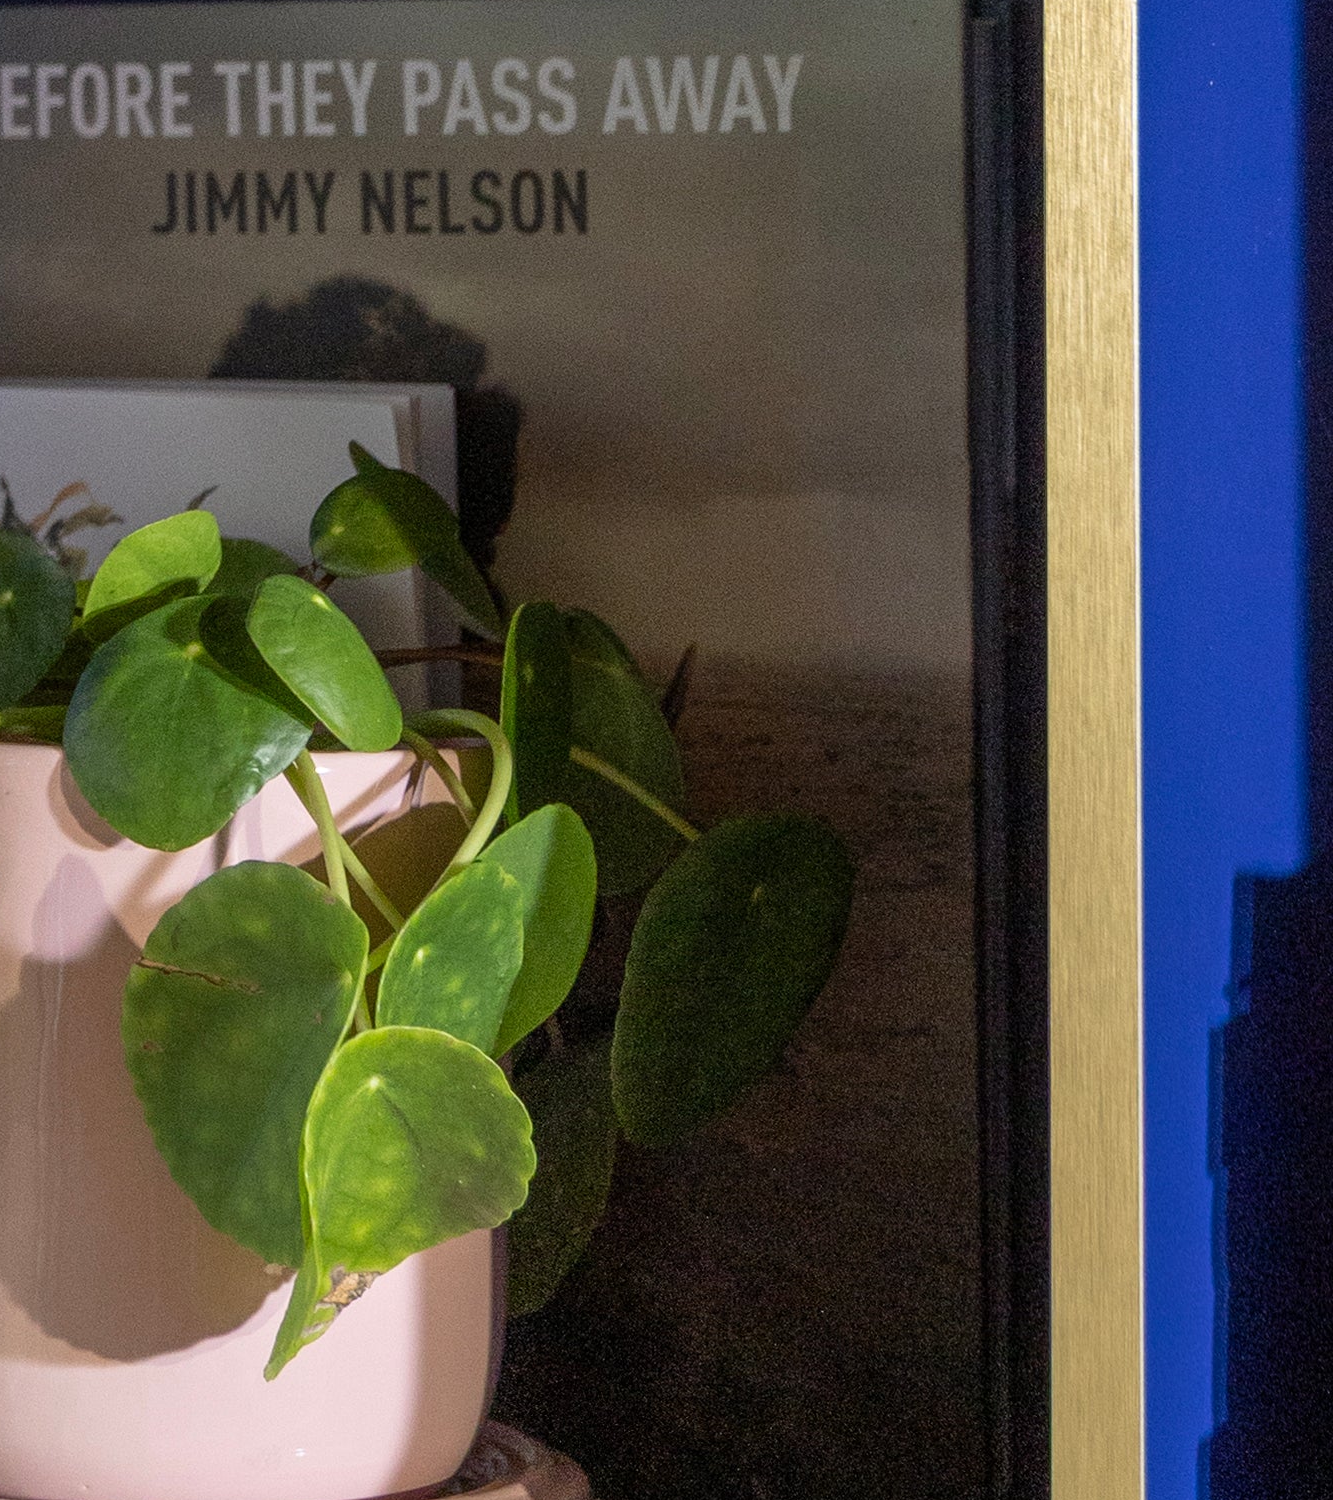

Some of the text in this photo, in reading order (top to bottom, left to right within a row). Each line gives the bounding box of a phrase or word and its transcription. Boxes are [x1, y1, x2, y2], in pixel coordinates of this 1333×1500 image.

[215, 58, 377, 139] THEY
[403, 56, 580, 137] PASS
[600, 53, 805, 136] AWAY
[150, 169, 591, 237] JIMMY NELSON
